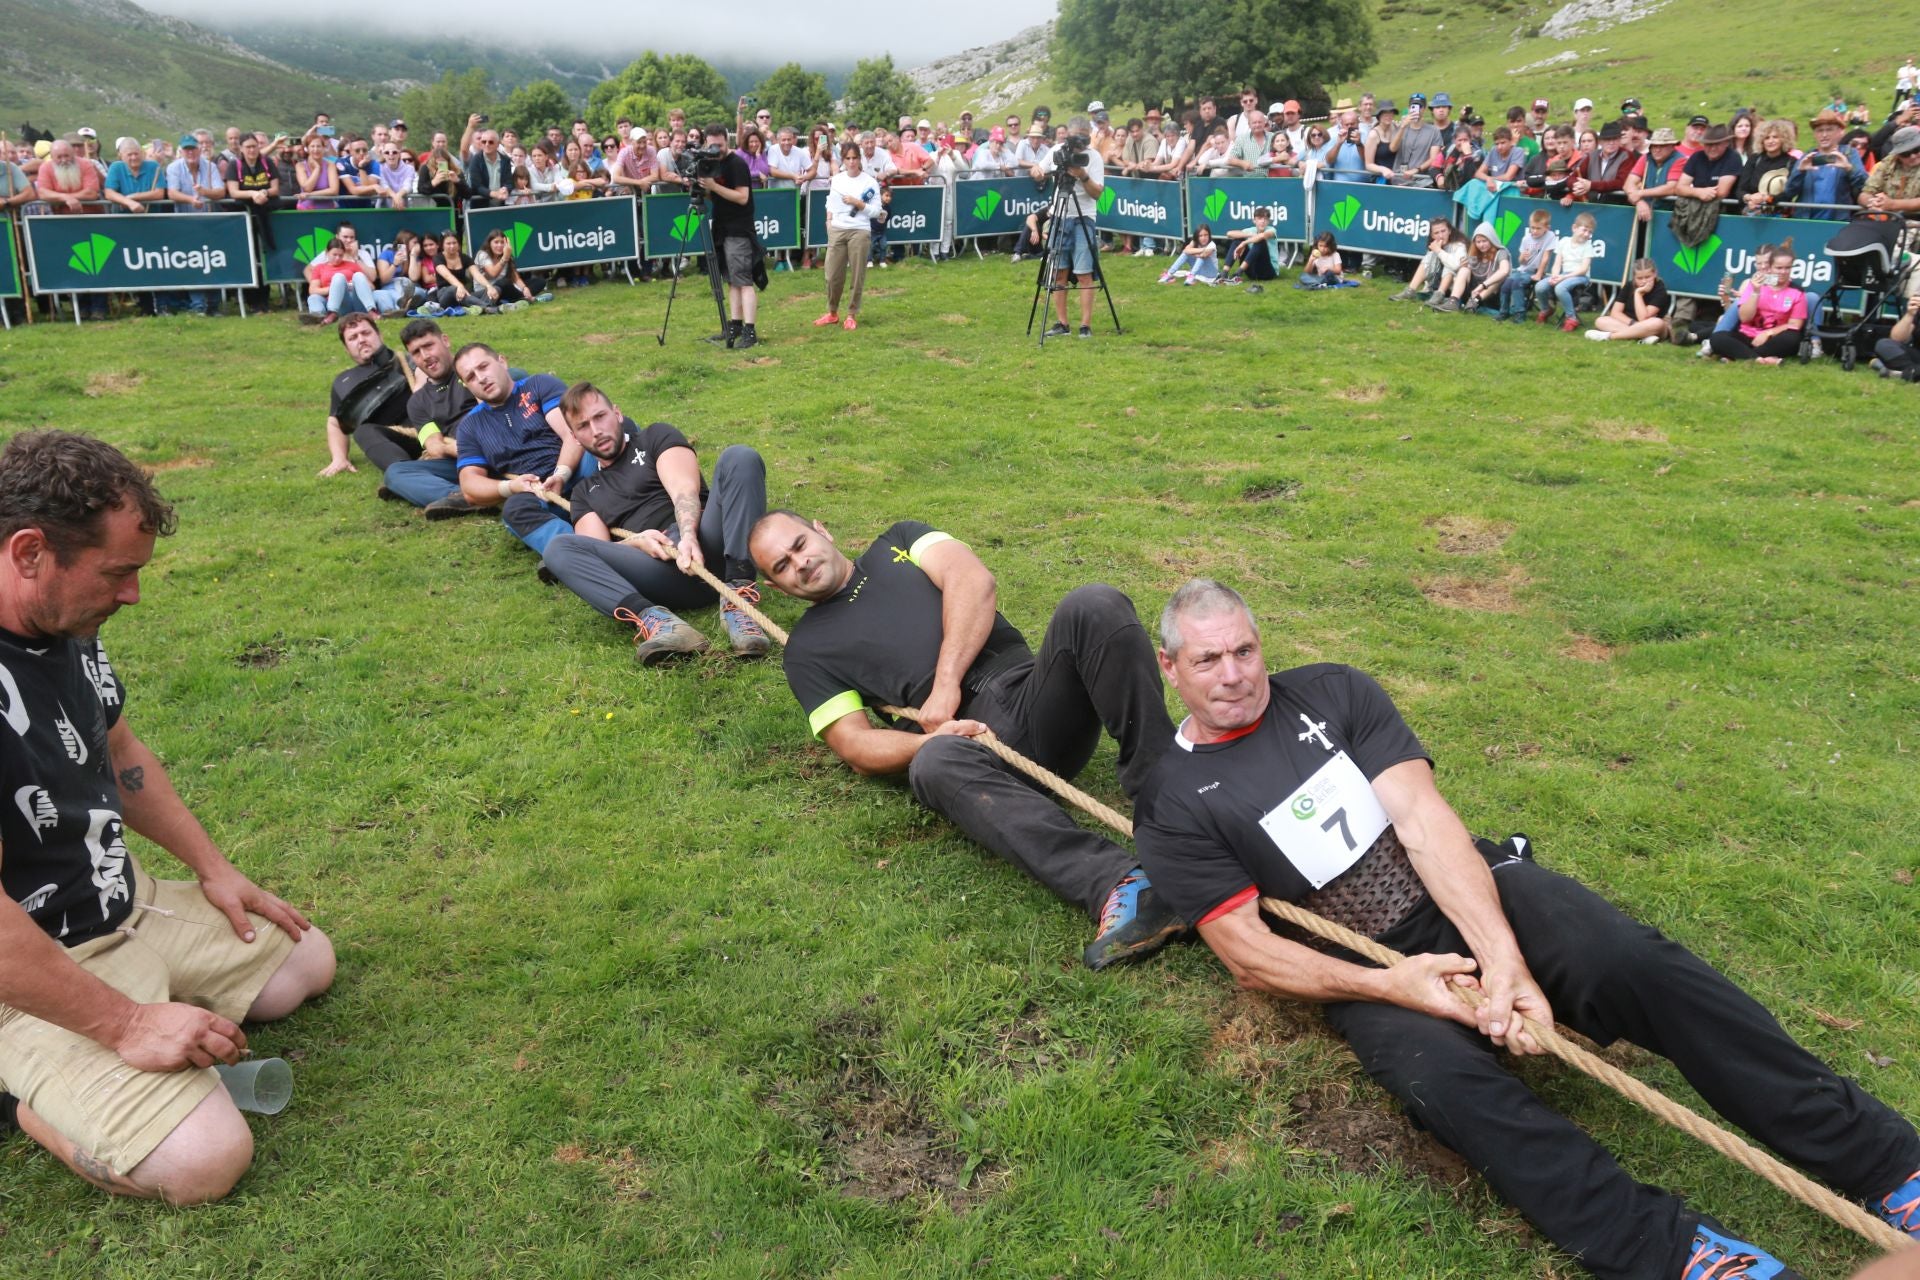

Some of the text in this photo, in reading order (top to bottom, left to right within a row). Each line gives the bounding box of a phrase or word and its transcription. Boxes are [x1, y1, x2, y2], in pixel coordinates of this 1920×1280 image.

[1117, 198, 1167, 224] Unicaja
[1363, 209, 1430, 242] Unicaja
[537, 226, 616, 252] Unicaja
[122, 245, 227, 274] Unicaja
[54, 718, 79, 759] NIKE
[36, 790, 59, 828] NIKE
[1320, 806, 1358, 851] 7
